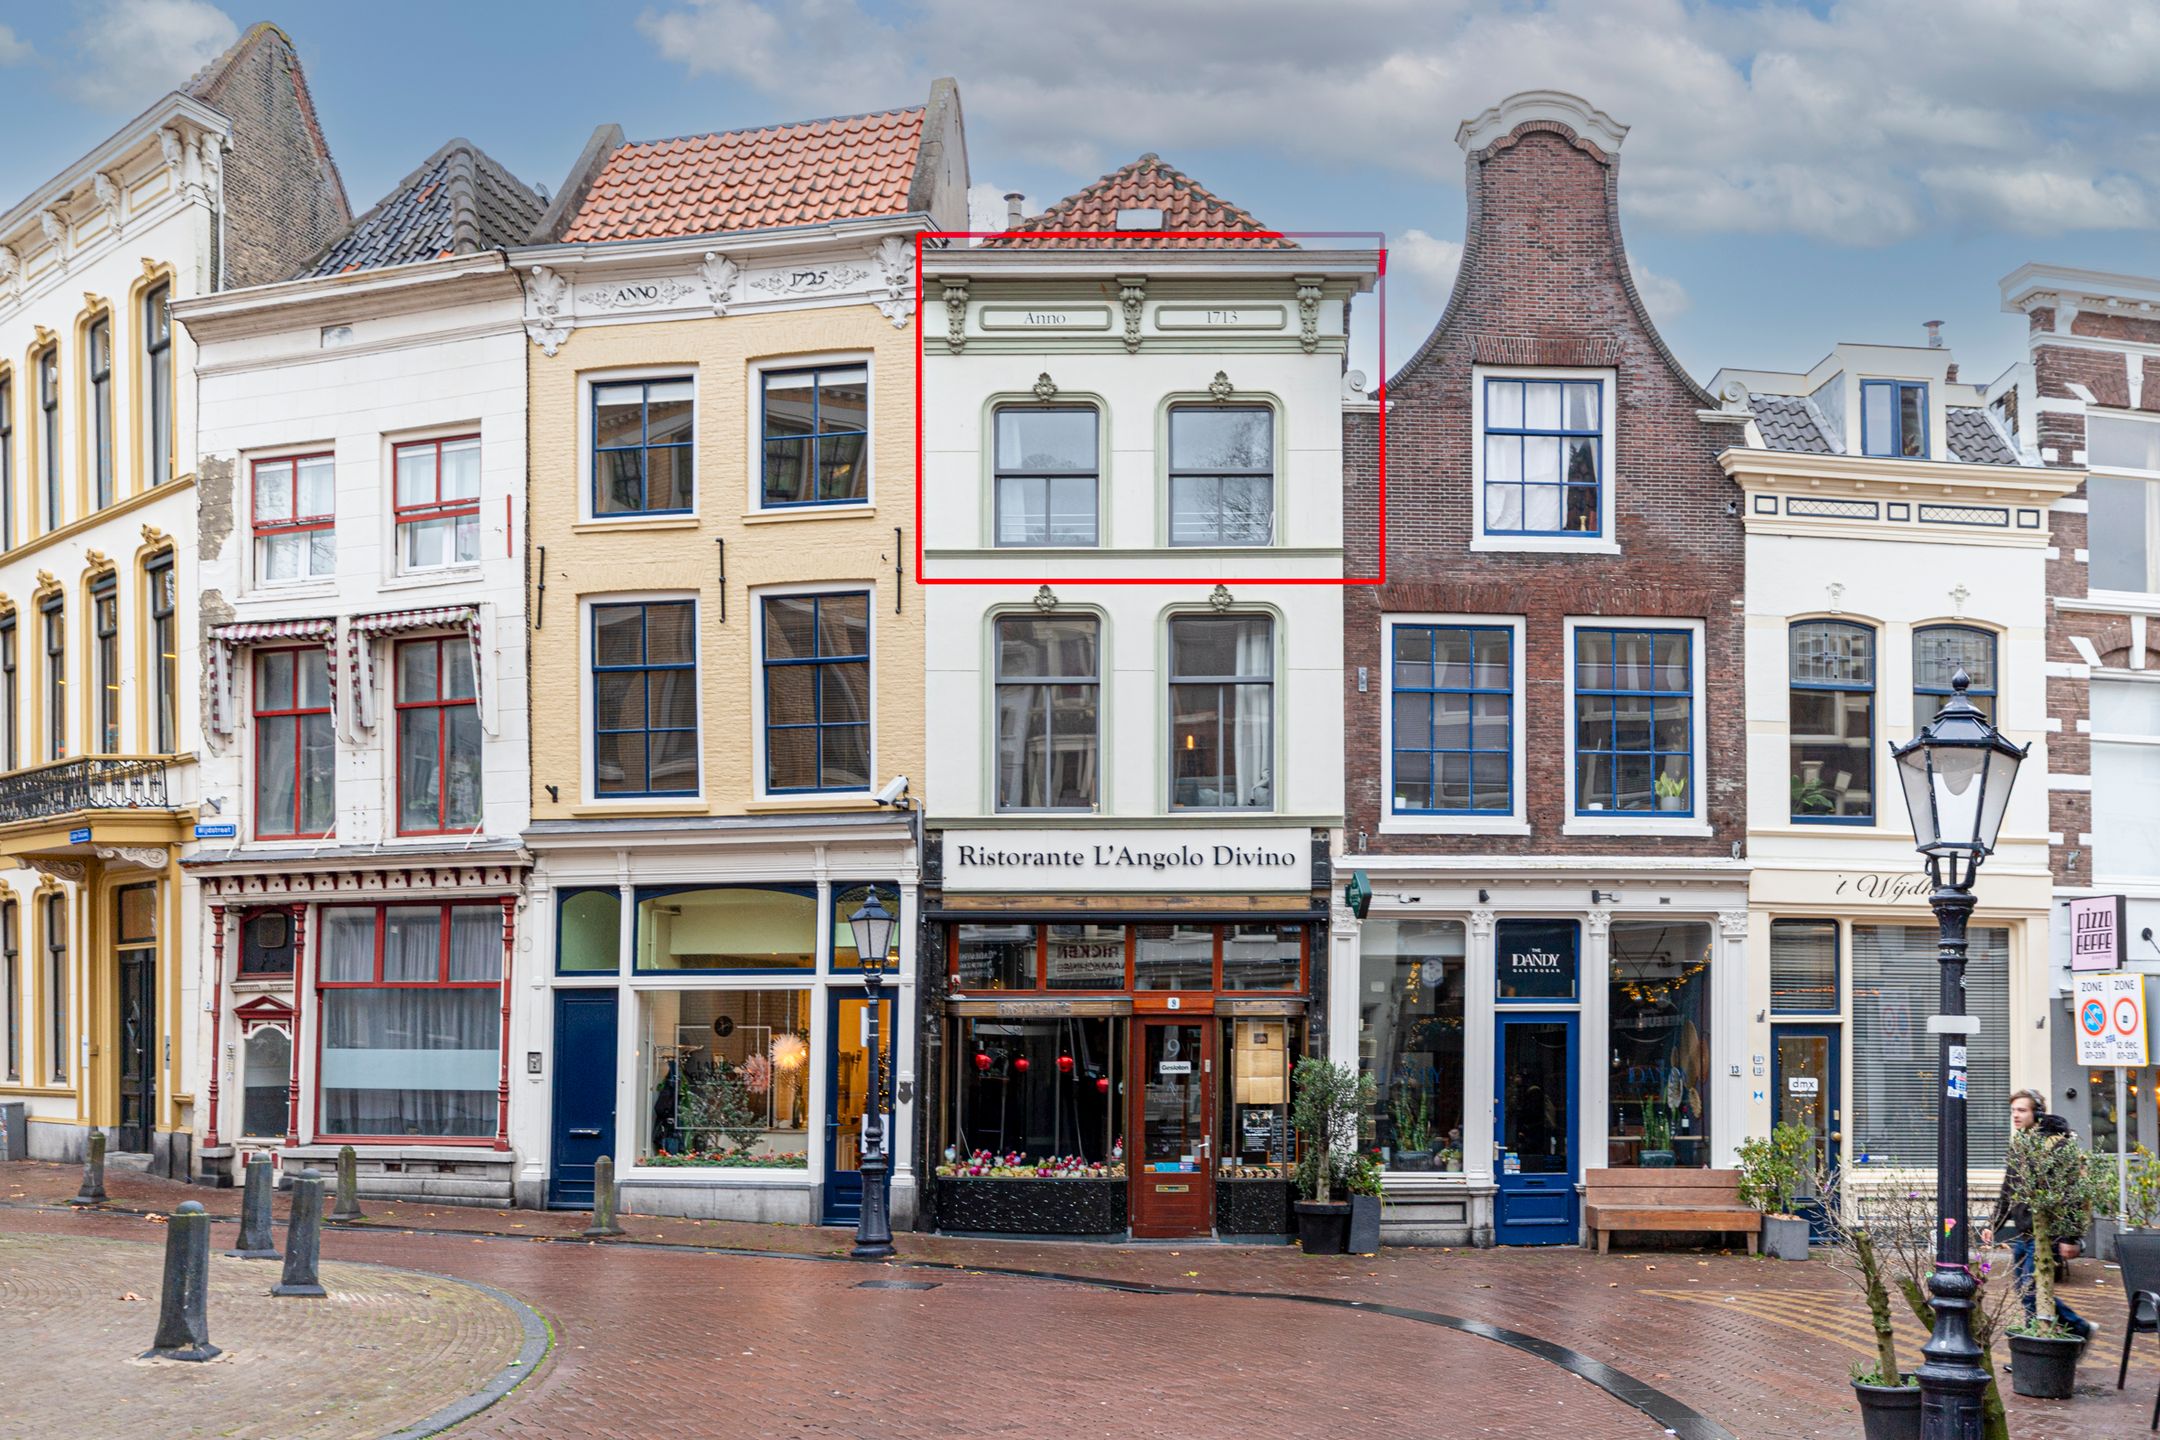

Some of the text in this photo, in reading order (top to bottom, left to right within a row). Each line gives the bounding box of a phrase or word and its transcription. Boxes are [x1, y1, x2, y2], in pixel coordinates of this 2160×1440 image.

[790, 271, 829, 287] 1725
[616, 286, 658, 301] ANNO
[1023, 311, 1067, 325] Anno
[1206, 310, 1239, 325] 1713
[957, 844, 1296, 871] Ristorante L'Angolo Divino
[1512, 953, 1560, 967] DANDY
[2081, 981, 2104, 993] ZONE
[2114, 979, 2135, 992] ZONE
[1167, 1038, 1181, 1058] 9
[2084, 1041, 2092, 1050] 12
[2116, 1041, 2123, 1049] 12
[1731, 1065, 1740, 1074] 13
[1792, 1077, 1815, 1089] dmx
